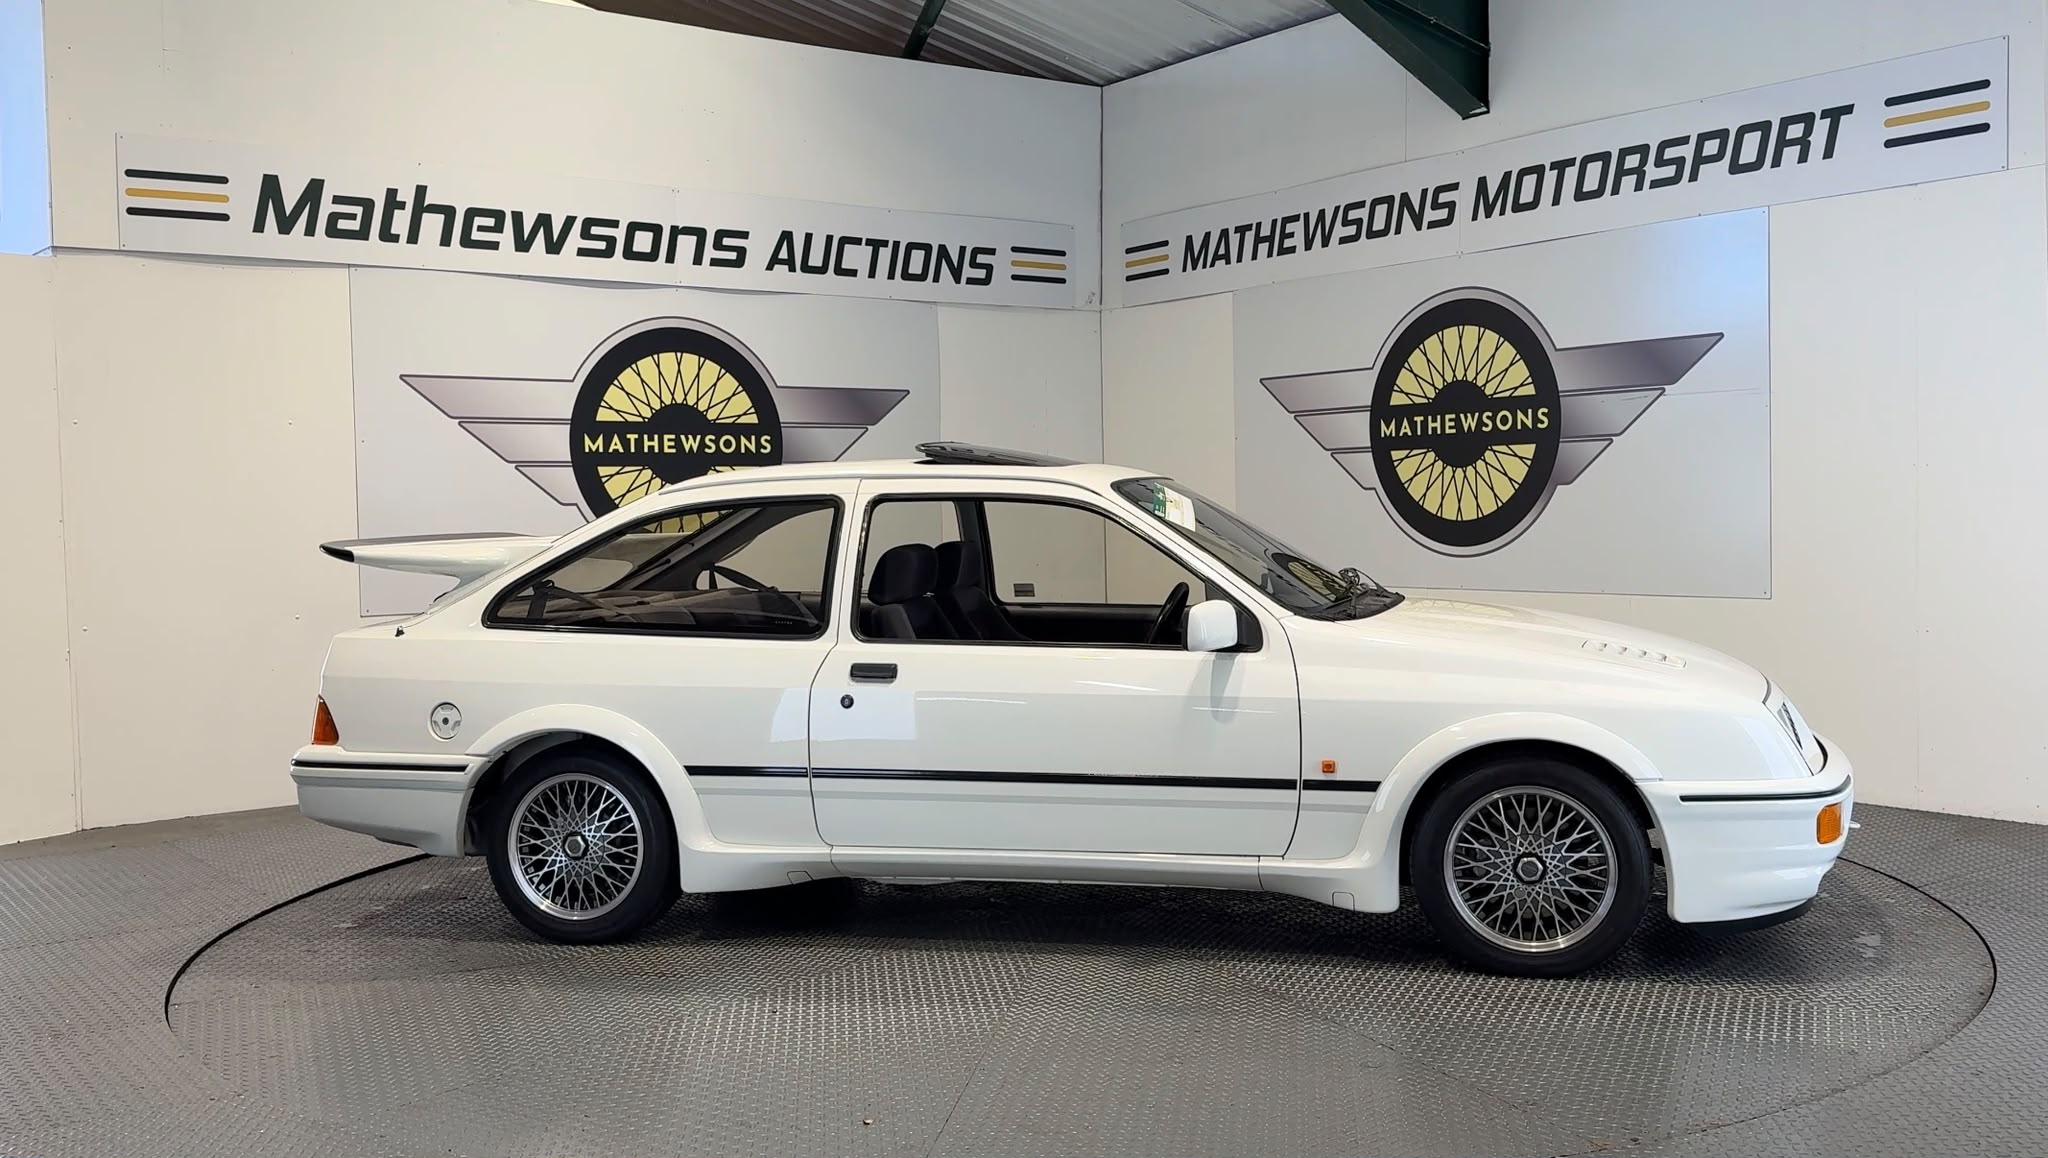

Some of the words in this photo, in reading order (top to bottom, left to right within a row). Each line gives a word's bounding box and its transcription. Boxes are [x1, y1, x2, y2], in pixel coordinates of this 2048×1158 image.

[1181, 181, 1461, 273] MATHEWSONS
[1471, 103, 1856, 222] MOTORSPORT
[252, 173, 750, 269] Mathewsons
[764, 229, 997, 287] AUCTIONS
[584, 433, 773, 454] MATHEWSONS
[1380, 407, 1549, 438] MATHEWSONS
